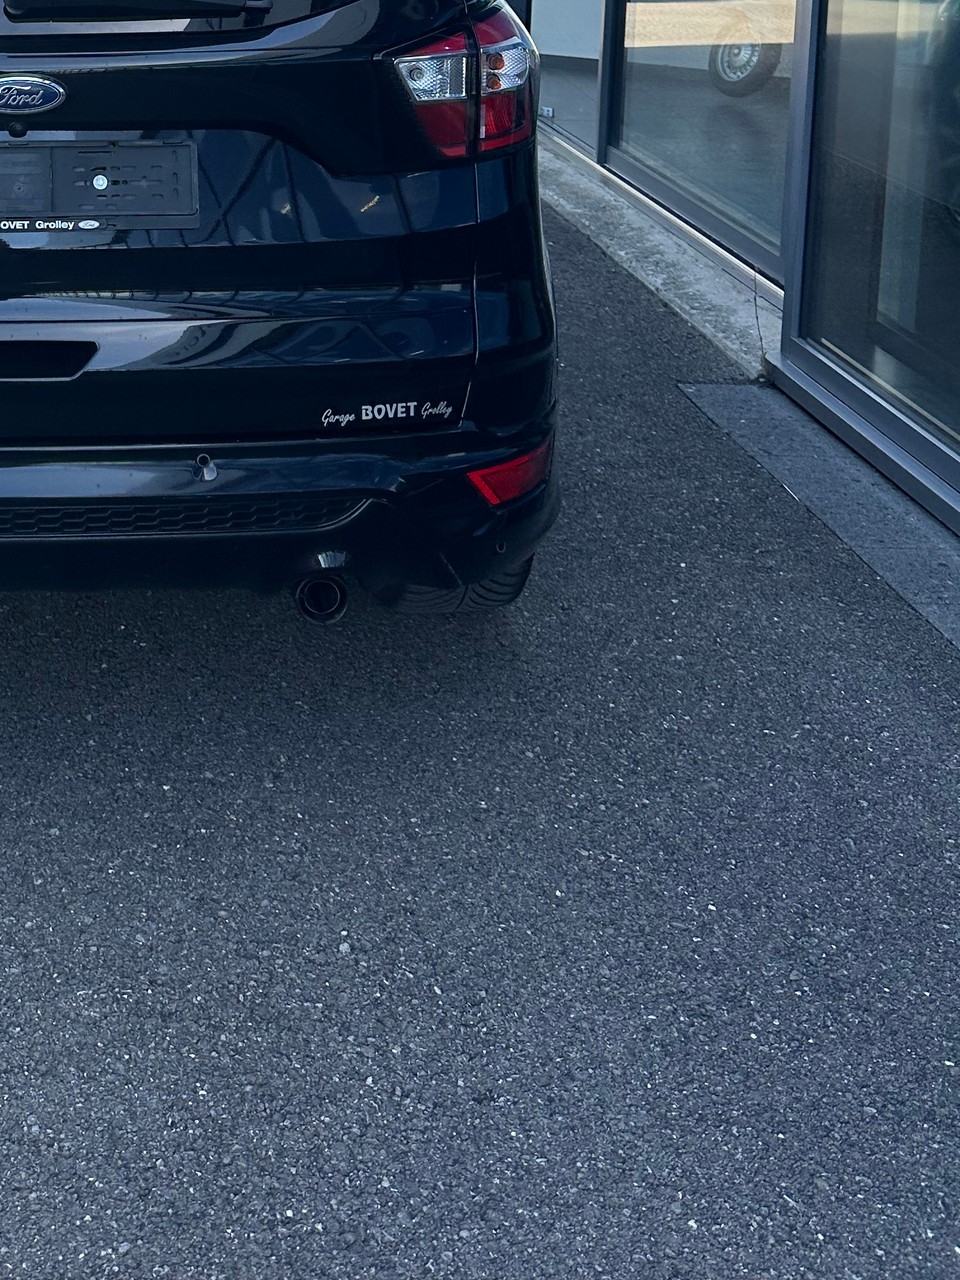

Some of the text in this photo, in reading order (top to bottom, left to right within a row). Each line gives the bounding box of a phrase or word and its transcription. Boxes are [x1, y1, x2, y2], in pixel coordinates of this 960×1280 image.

[35, 220, 75, 231] Grolley
[321, 401, 453, 427] Garage BOVET Grolley
